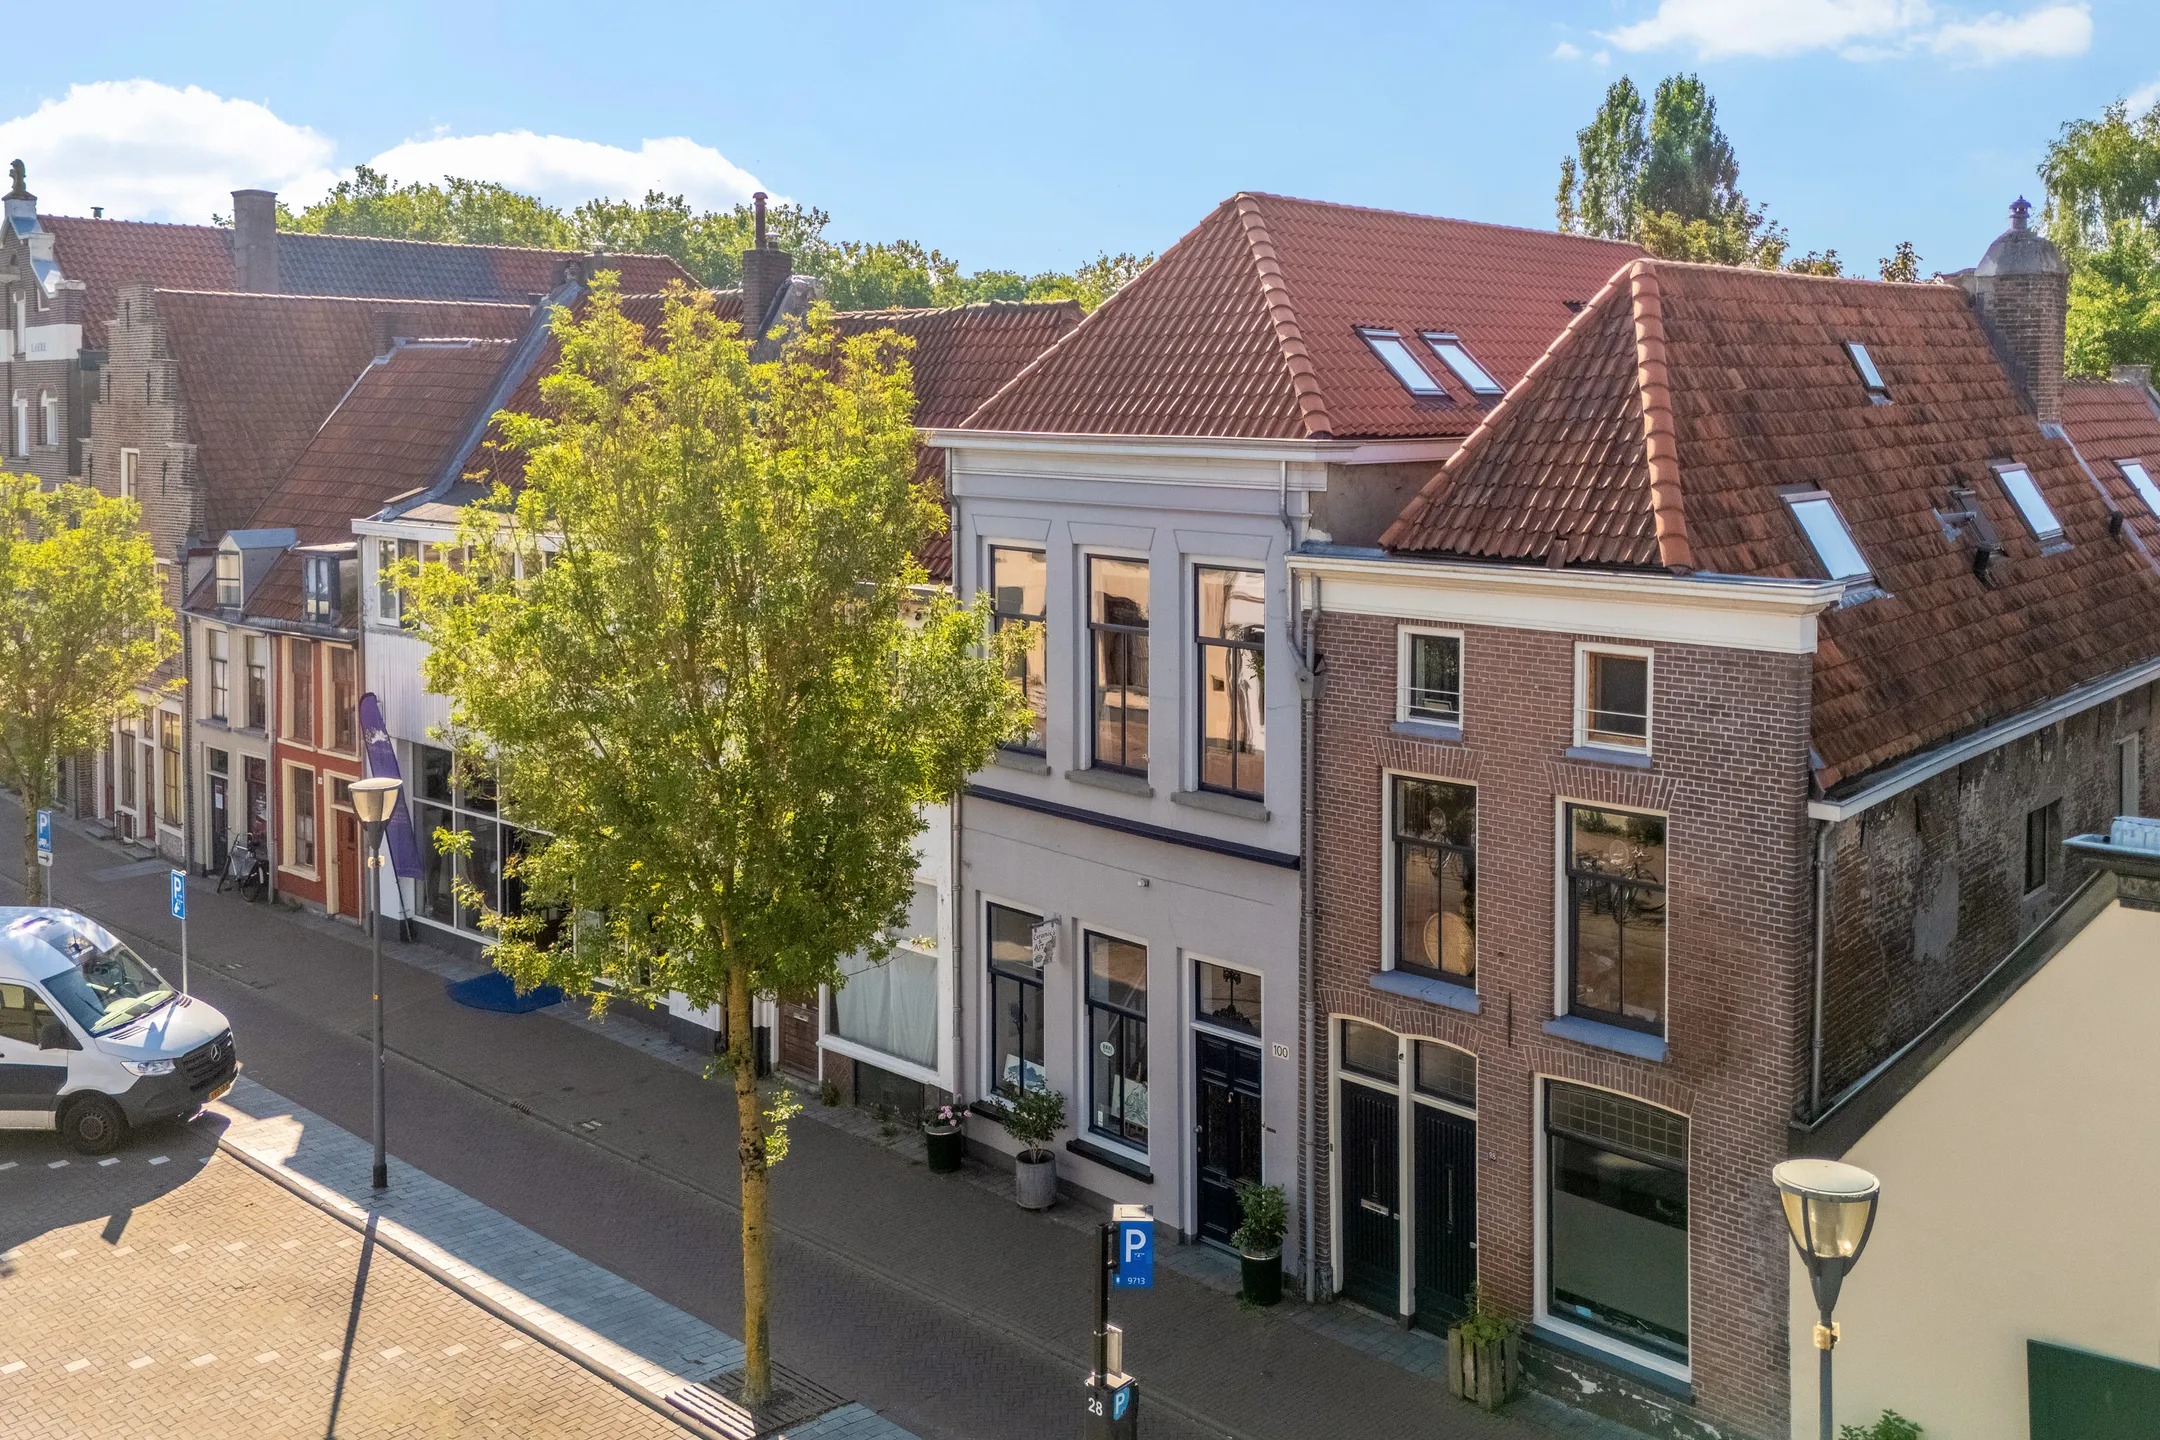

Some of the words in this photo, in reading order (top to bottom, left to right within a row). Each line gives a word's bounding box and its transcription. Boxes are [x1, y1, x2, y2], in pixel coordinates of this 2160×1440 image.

[40, 814, 48, 833] P
[174, 877, 182, 898] P
[1274, 1045, 1288, 1058] 100
[1126, 1229, 1146, 1262] P
[1127, 1277, 1146, 1285] 9713
[1088, 1397, 1104, 1416] 28
[1115, 1393, 1126, 1415] P
